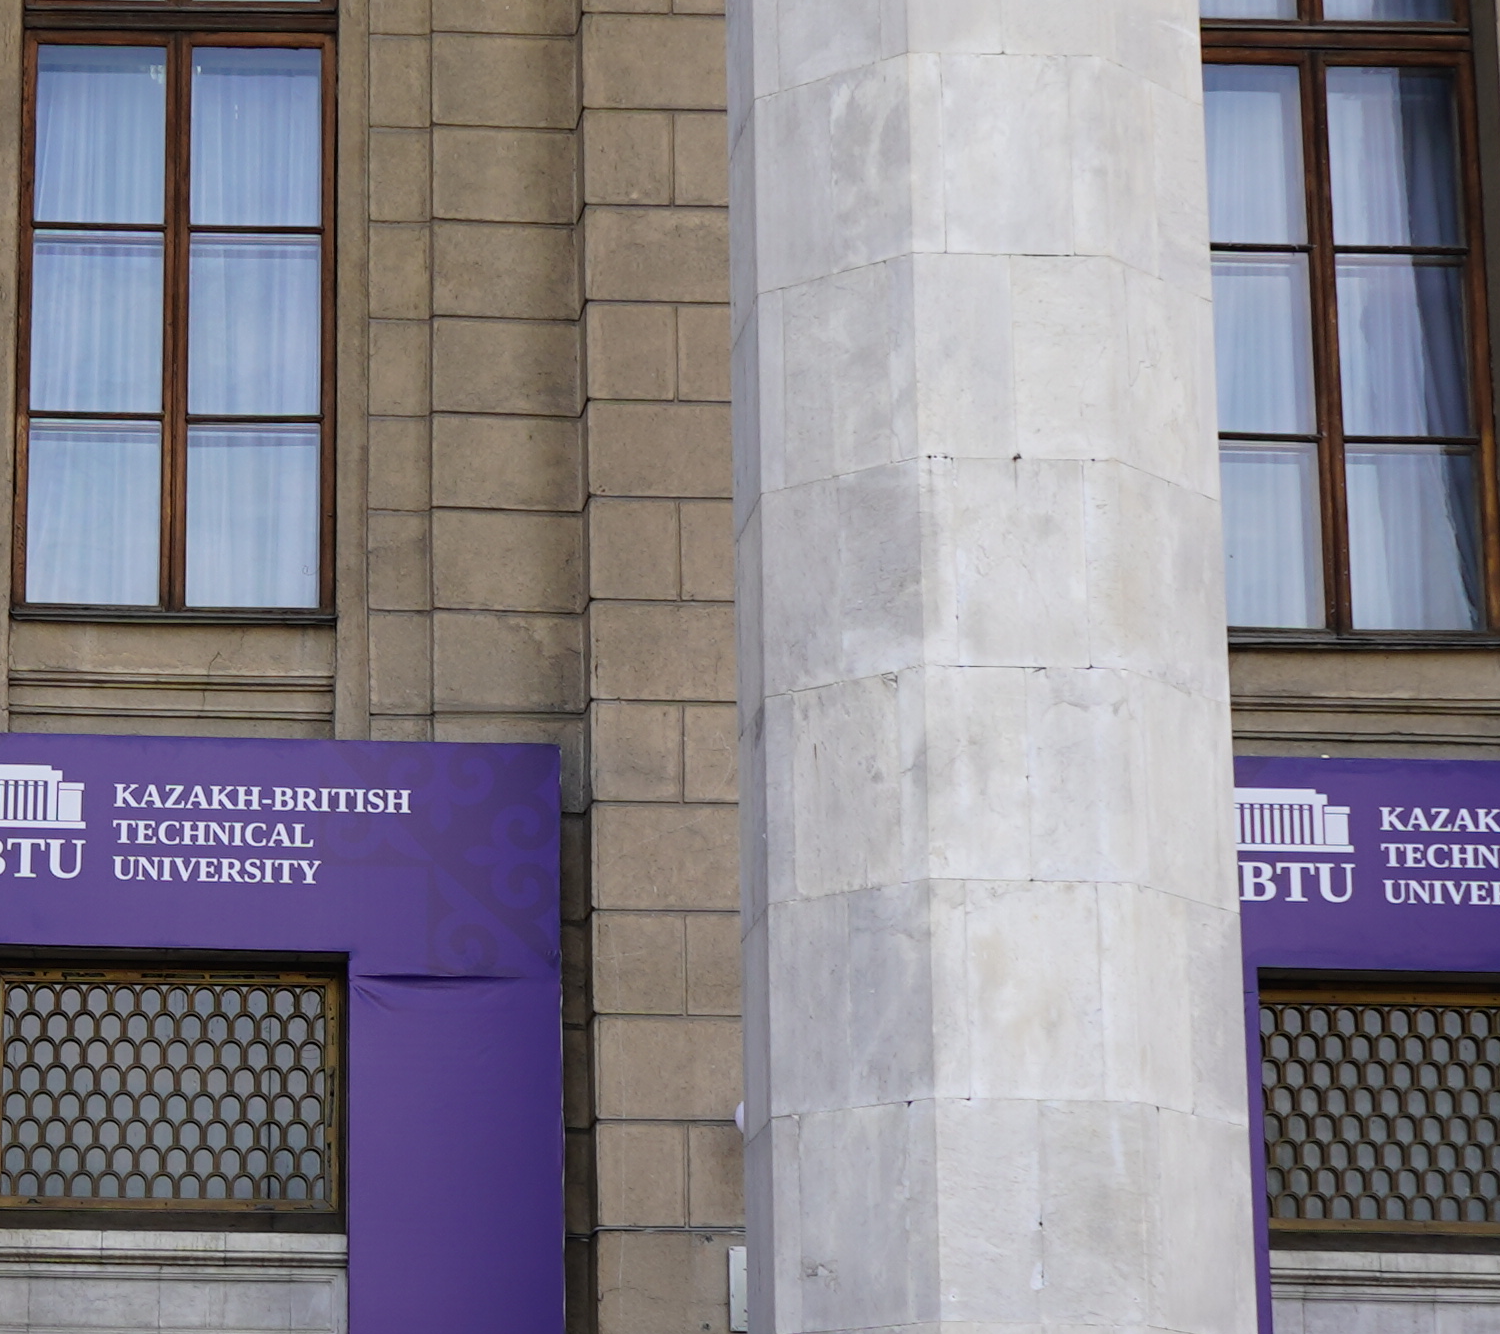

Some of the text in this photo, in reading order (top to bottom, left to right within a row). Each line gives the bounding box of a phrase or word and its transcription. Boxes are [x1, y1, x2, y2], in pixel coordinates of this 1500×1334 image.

[114, 784, 411, 813] KAZAKH-BRITISH
[113, 820, 313, 847] TECHNICAL
[113, 856, 321, 883] UNIVERSITY
[1238, 861, 1355, 902] BTU
